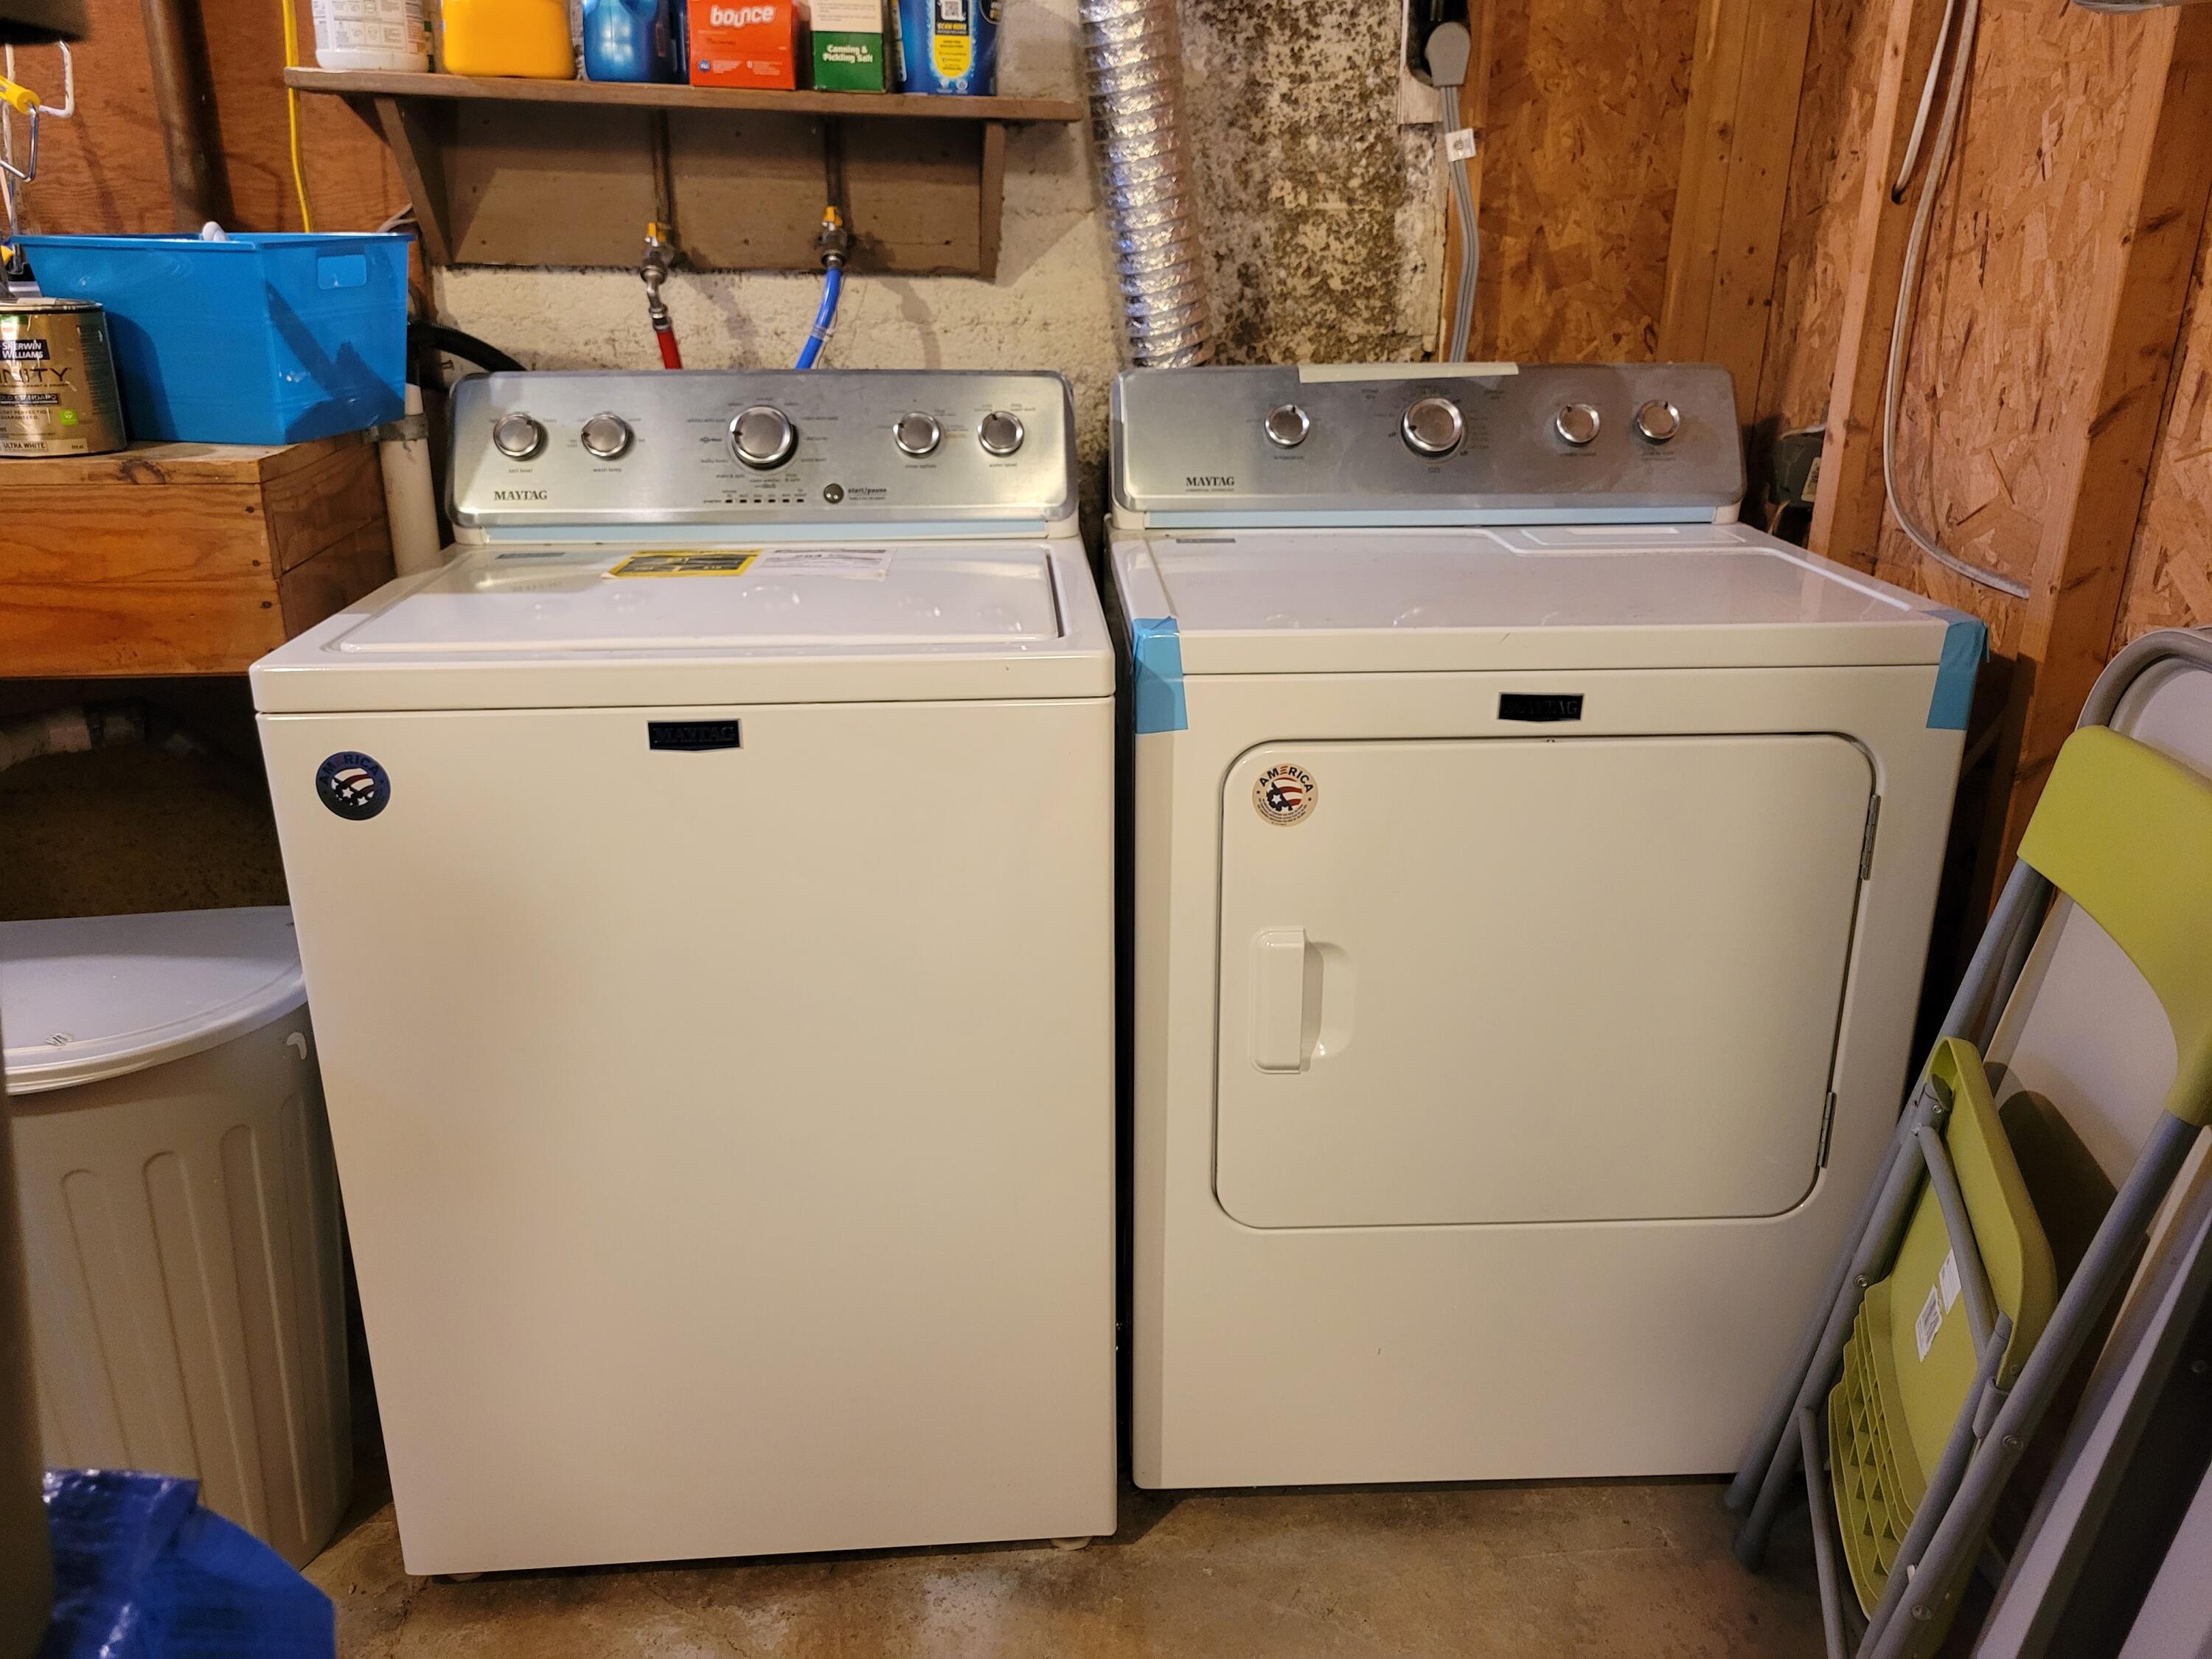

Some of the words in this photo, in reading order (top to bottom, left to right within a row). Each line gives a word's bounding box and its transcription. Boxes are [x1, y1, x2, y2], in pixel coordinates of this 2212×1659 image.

[710, 4, 775, 28] bounce
[827, 45, 860, 56] Canning
[861, 46, 868, 54] &
[822, 52, 855, 63] Pickling
[857, 54, 873, 63] Salt
[1186, 476, 1235, 487] MAYTAG
[493, 490, 548, 501] MAYTAG
[848, 487, 887, 495] start/pause
[319, 754, 380, 786] AMERICA
[1259, 765, 1314, 793] AMERICA
